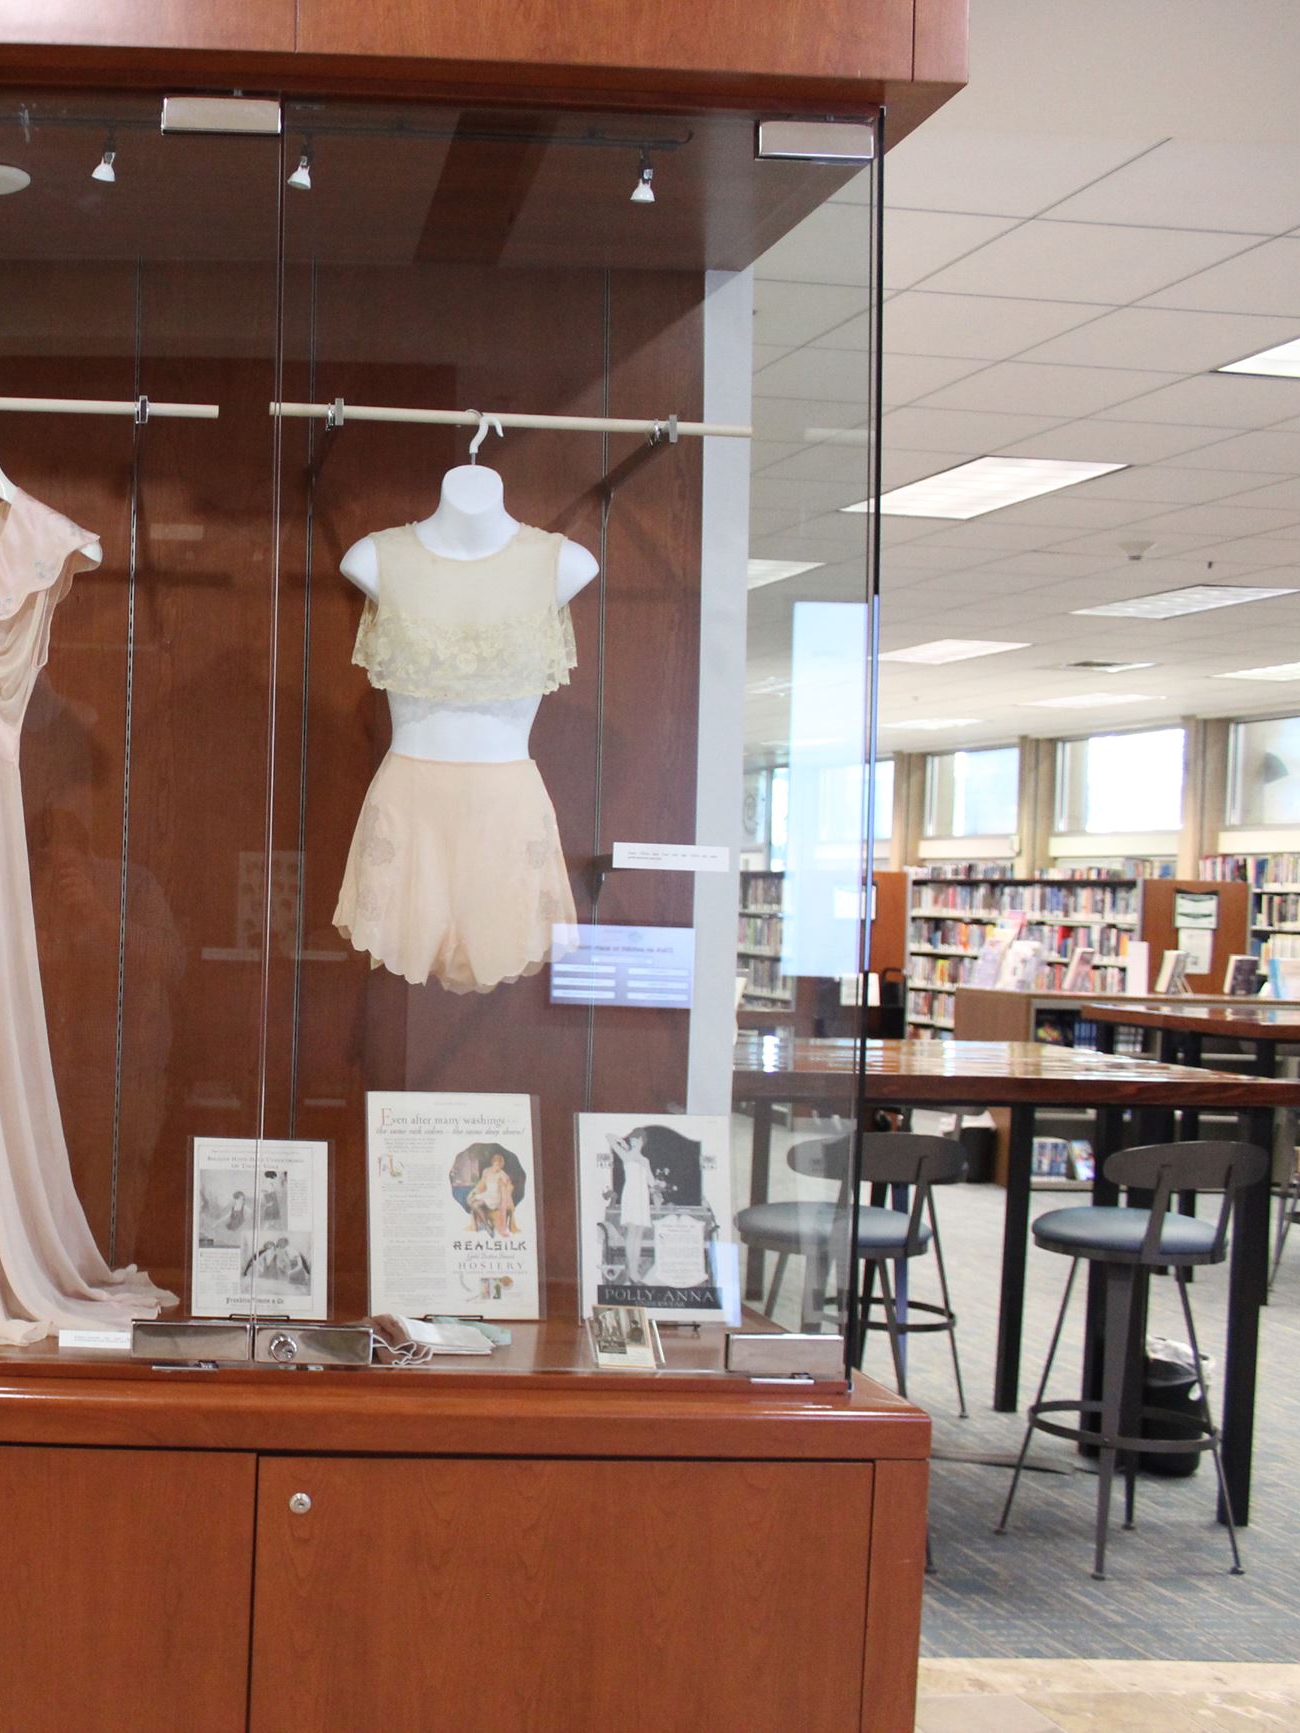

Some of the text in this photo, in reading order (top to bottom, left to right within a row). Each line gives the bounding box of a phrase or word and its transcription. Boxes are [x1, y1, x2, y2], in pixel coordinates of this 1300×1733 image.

[380, 1108, 408, 1127] Even
[411, 1114, 433, 1125] after
[434, 1116, 460, 1127] many
[453, 1240, 528, 1251] REALSILK
[604, 1288, 715, 1303] POLLY ANNA
